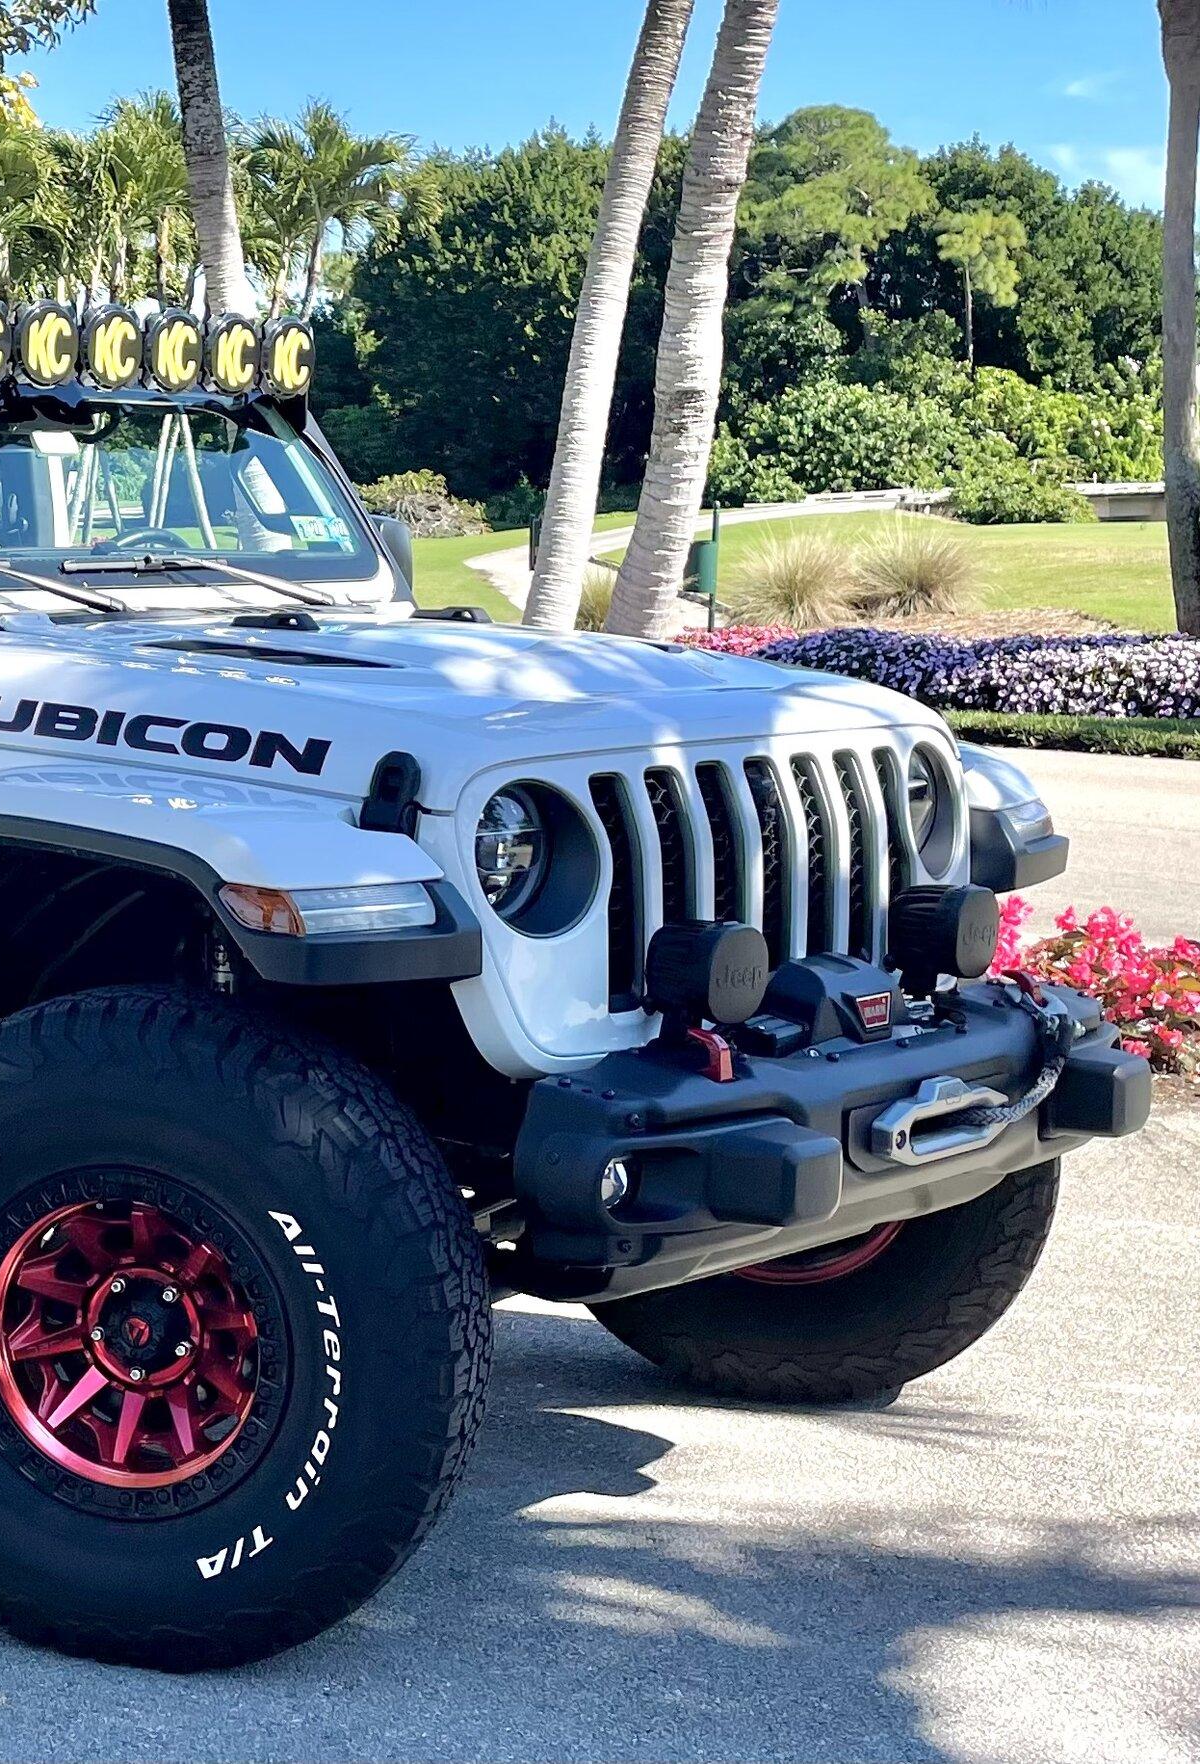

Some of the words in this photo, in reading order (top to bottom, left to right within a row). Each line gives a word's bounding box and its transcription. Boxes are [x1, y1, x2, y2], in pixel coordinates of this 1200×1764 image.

[27, 312, 72, 379] KC
[94, 316, 136, 381] KC
[157, 321, 197, 384] KC
[218, 323, 255, 386] KC
[274, 326, 309, 389] KC
[716, 964, 763, 990] Jeep
[268, 1210, 340, 1510] All-Terrain
[196, 1525, 273, 1579] T/A
